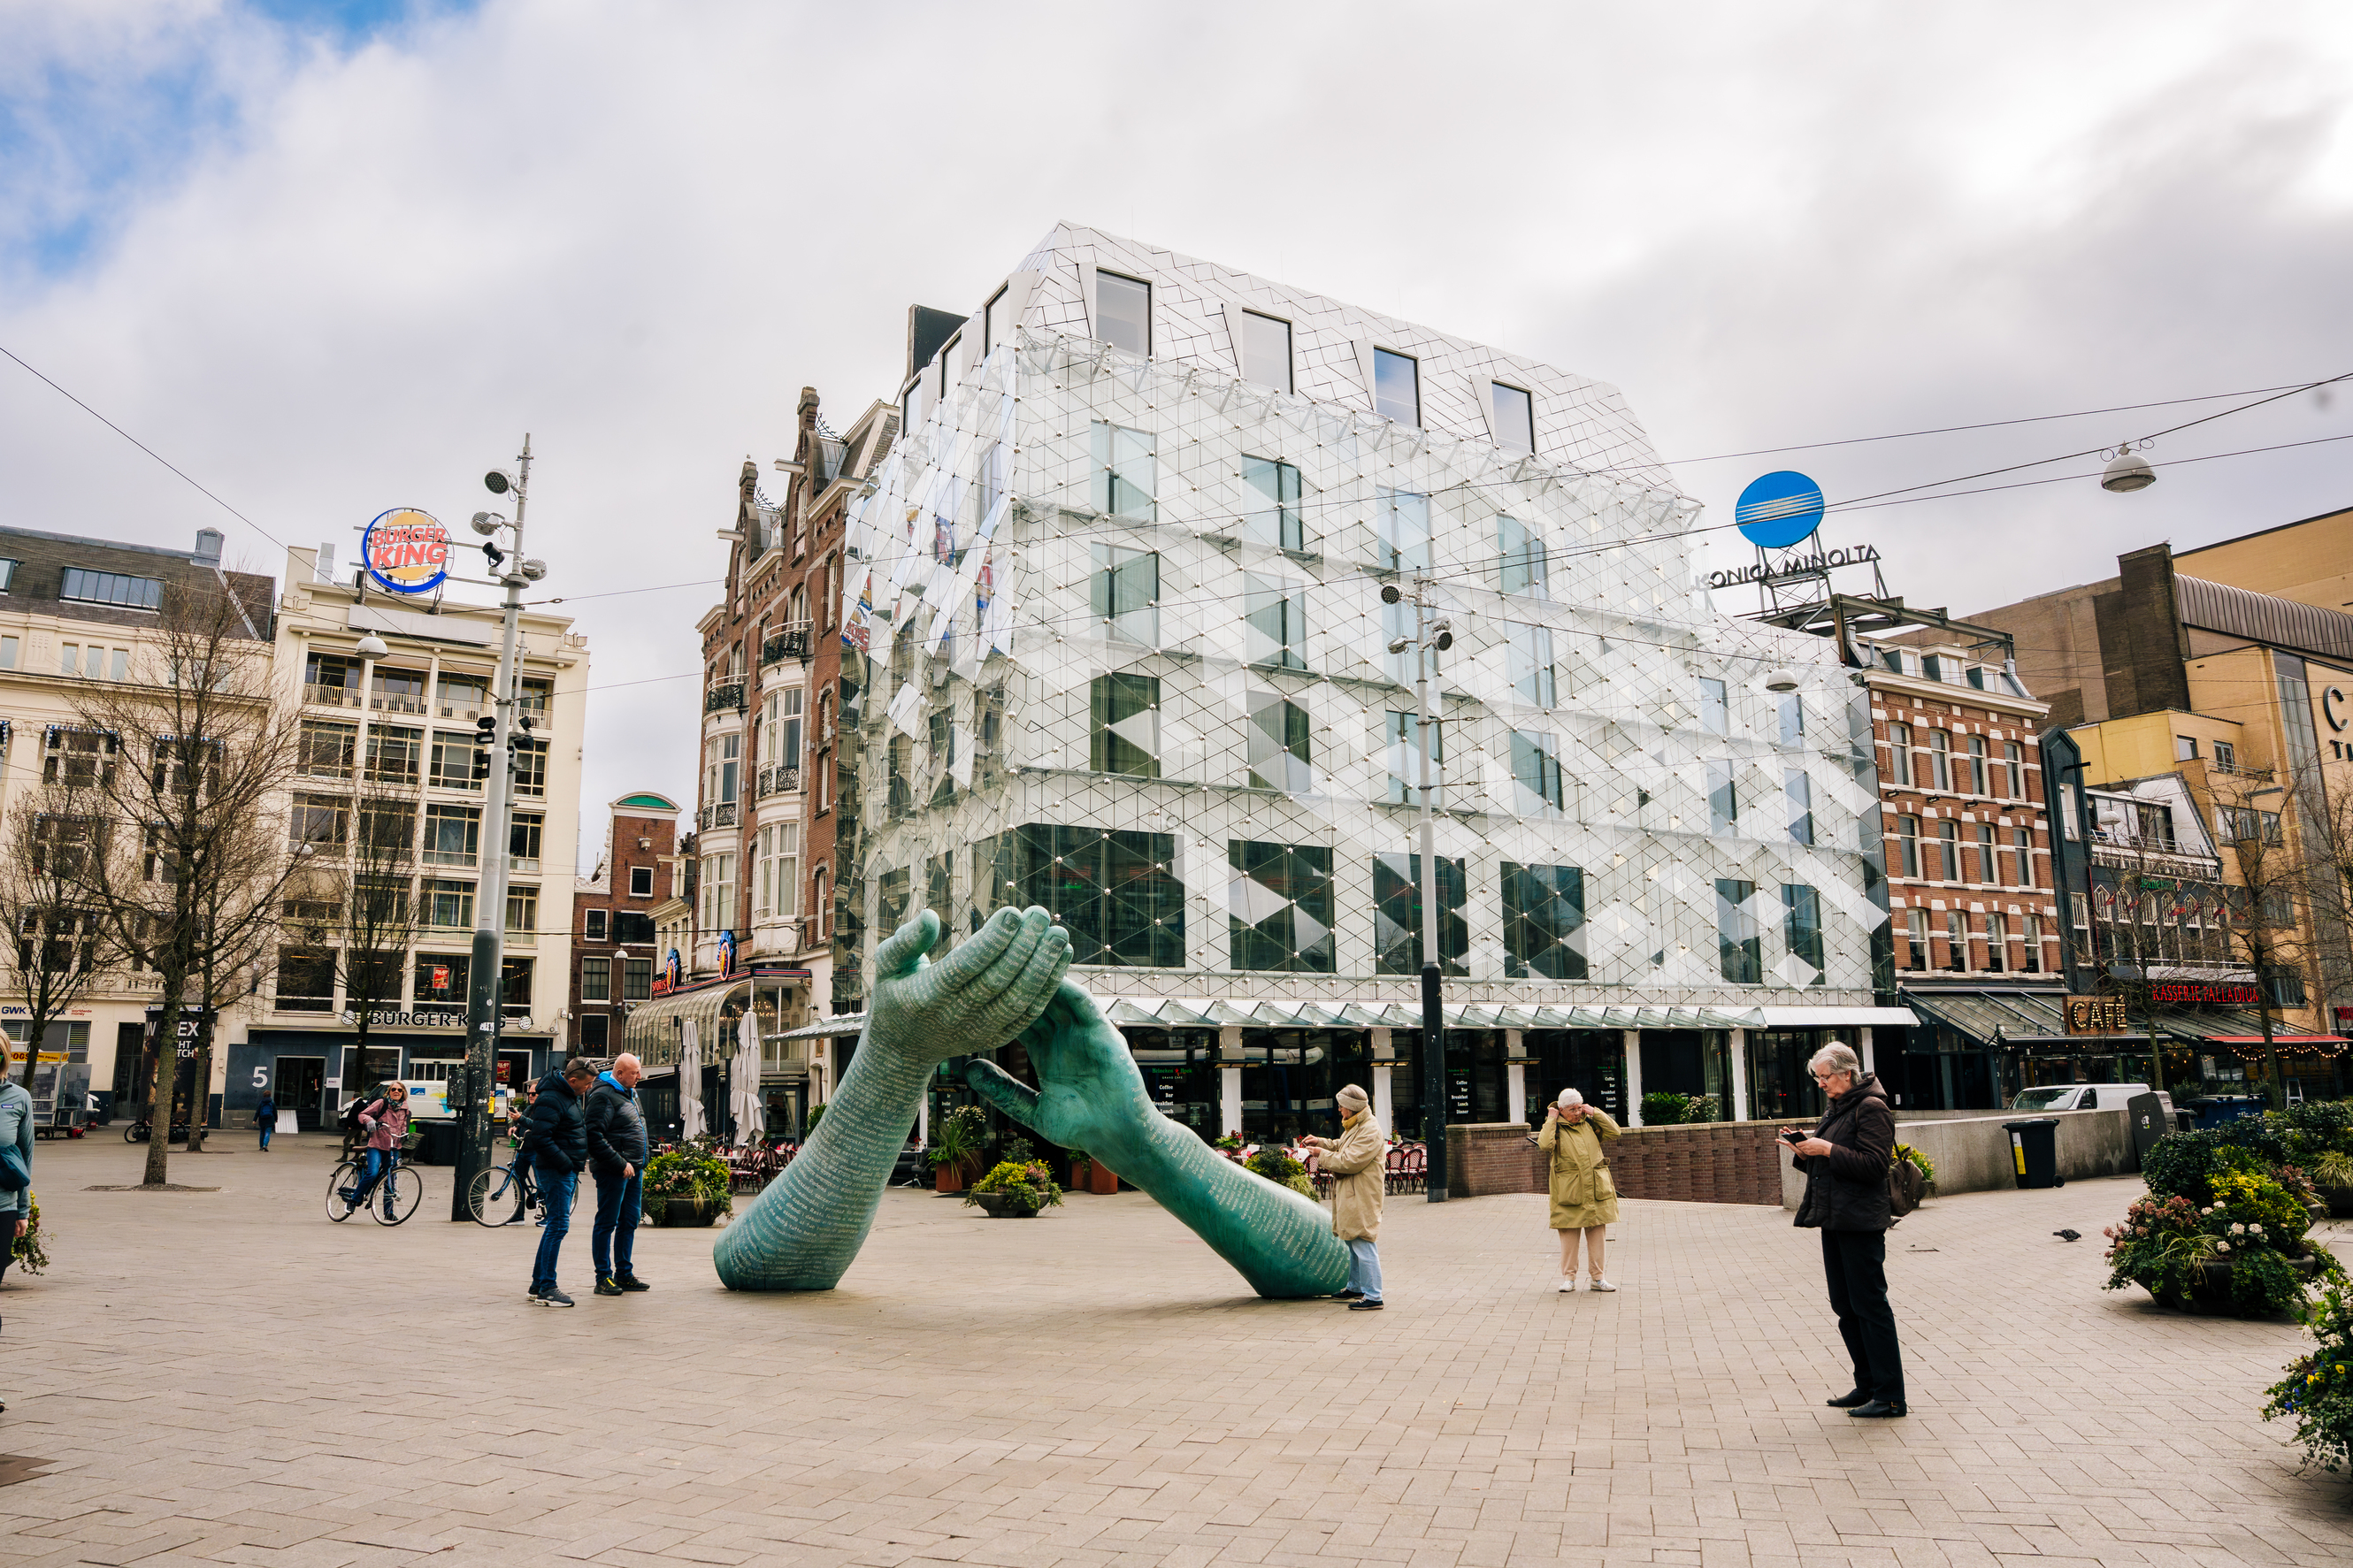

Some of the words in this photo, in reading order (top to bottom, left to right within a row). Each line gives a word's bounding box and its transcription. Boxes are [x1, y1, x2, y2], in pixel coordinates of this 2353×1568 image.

[372, 527, 446, 547] BURGER
[372, 543, 448, 569] KING
[1783, 544, 1882, 575] MINOLTA
[2149, 984, 2201, 1001] RASSERIE
[29, 1006, 66, 1015] Trelx
[369, 1010, 451, 1027] BURGER
[457, 1013, 507, 1029] KG
[2071, 994, 2127, 1028] CAFÉ
[252, 1066, 268, 1088] 5
